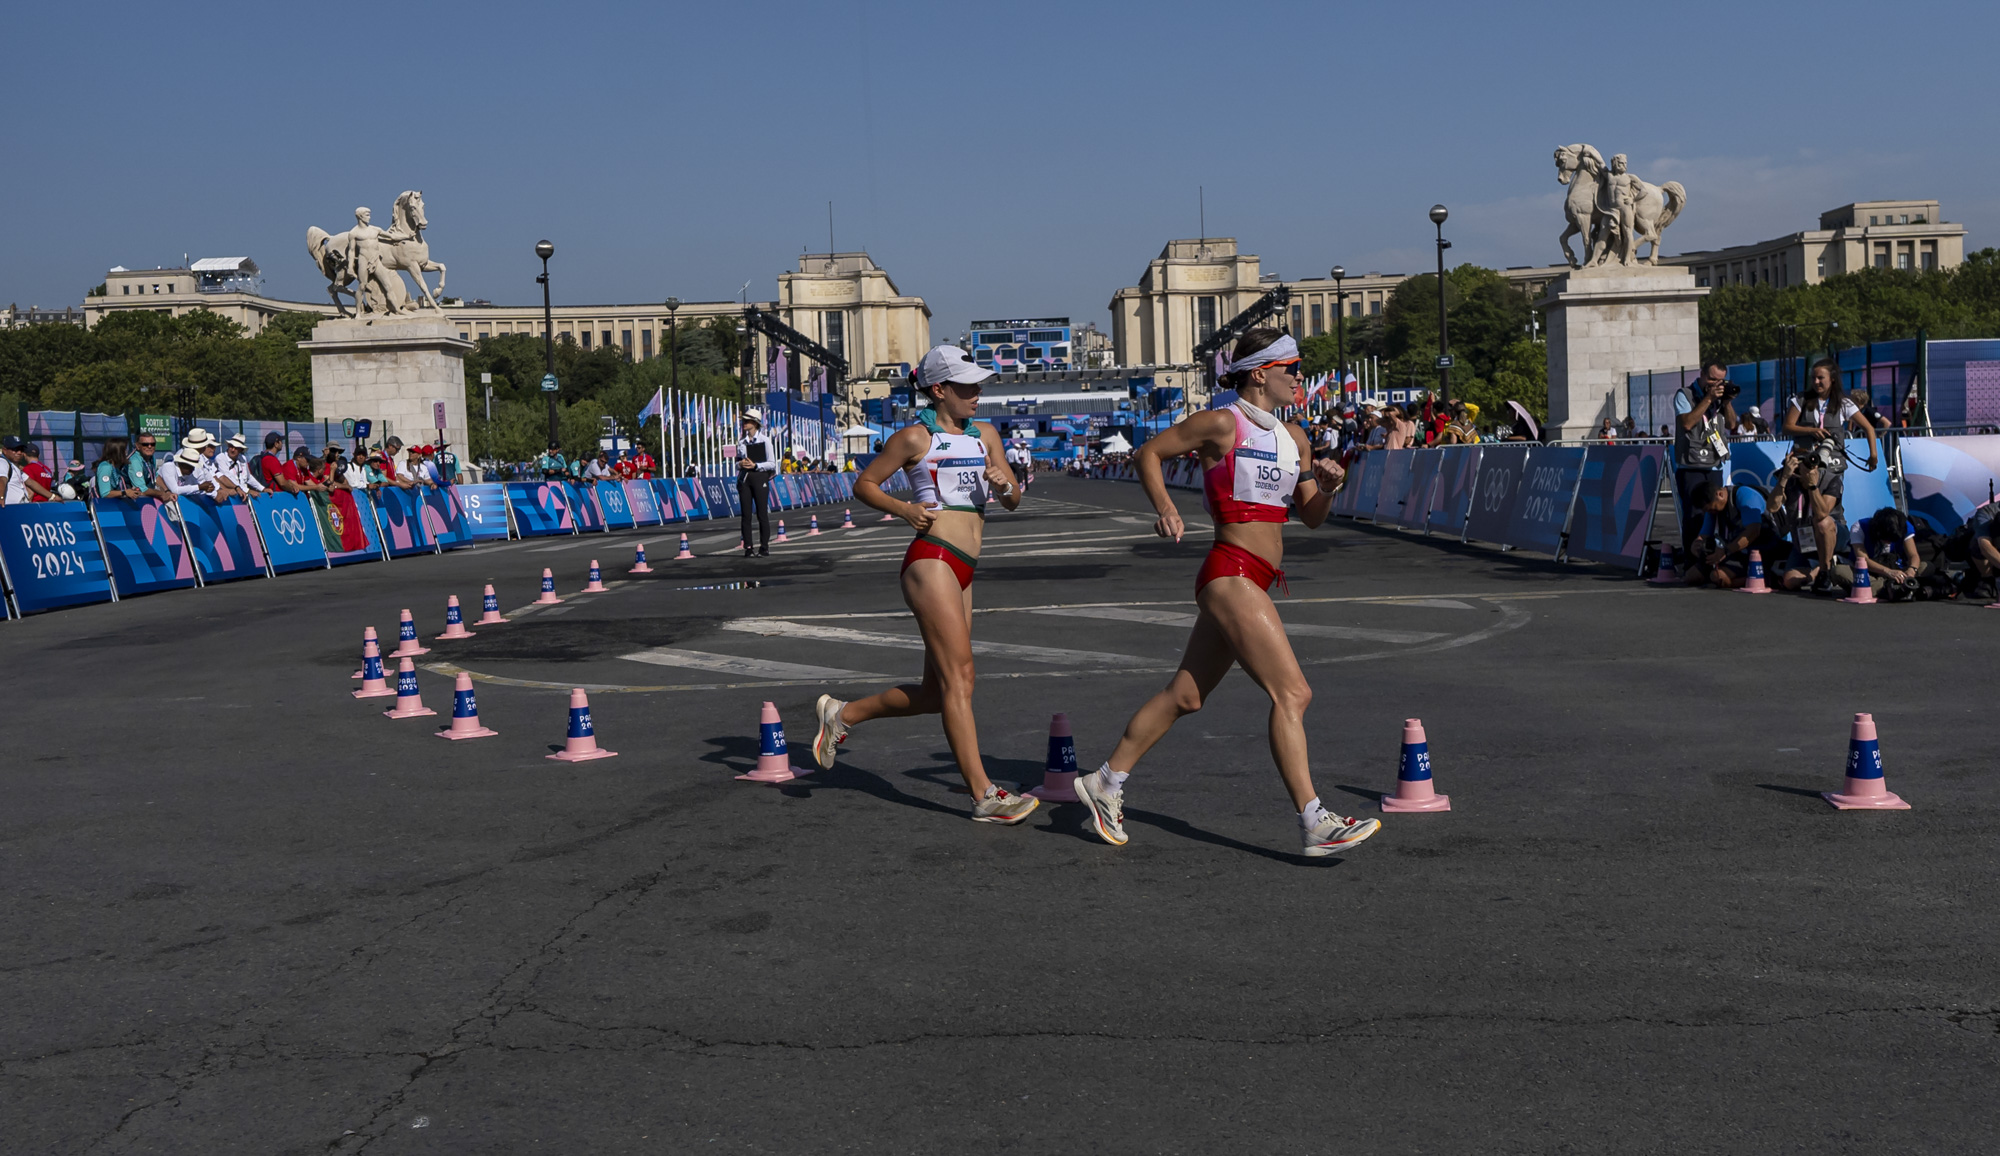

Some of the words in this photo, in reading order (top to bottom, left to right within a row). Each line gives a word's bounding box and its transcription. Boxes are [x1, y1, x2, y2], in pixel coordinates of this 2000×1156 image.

[146, 418, 164, 427] SORTIE
[957, 471, 977, 485] 133
[1256, 465, 1282, 482] 150
[1522, 495, 1555, 523] 2024
[32, 551, 86, 579] 2024
